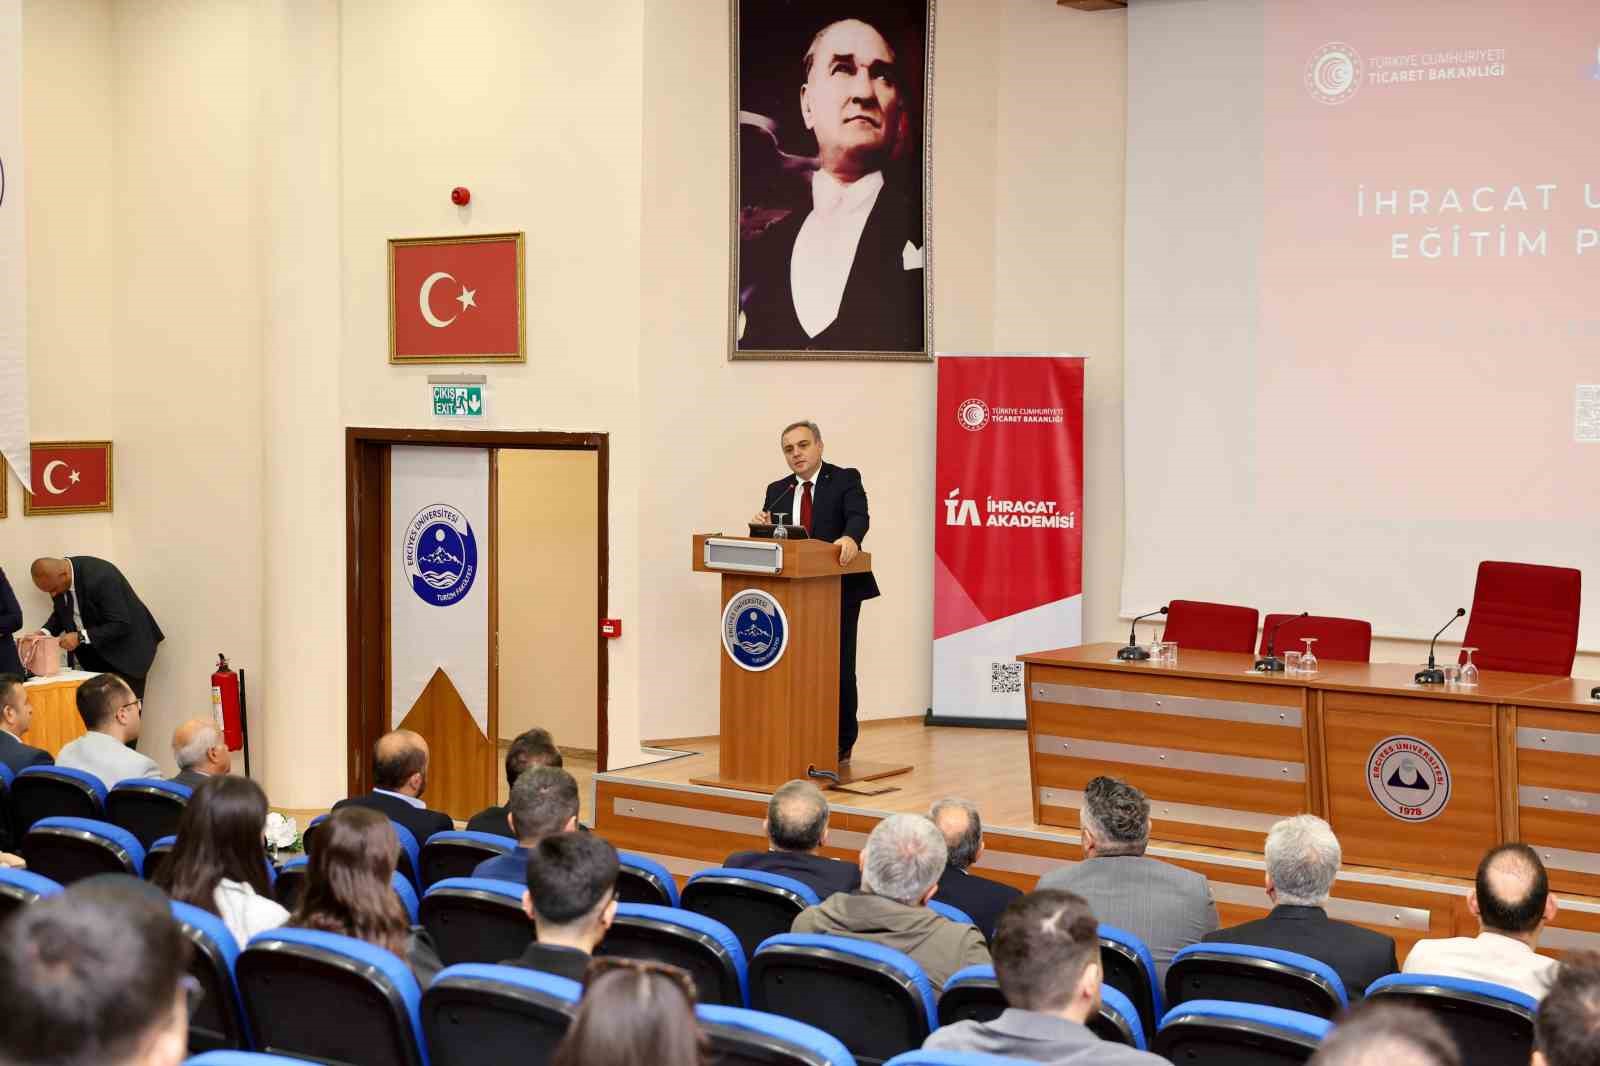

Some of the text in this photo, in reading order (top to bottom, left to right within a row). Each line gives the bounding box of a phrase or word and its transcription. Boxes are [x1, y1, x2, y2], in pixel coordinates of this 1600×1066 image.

[1368, 62, 1505, 84] TİCARET BAKANLIĞI
[1357, 184, 1557, 216] İHRACAT
[1391, 224, 1547, 259] EĞİTİM
[436, 402, 455, 415] EXIT
[992, 415, 1064, 424] TİCARET BAKANLIĞI
[986, 496, 1057, 513] İHRACAT
[986, 512, 1075, 529] AKADEMİSİ
[1398, 806, 1423, 816] 1978
